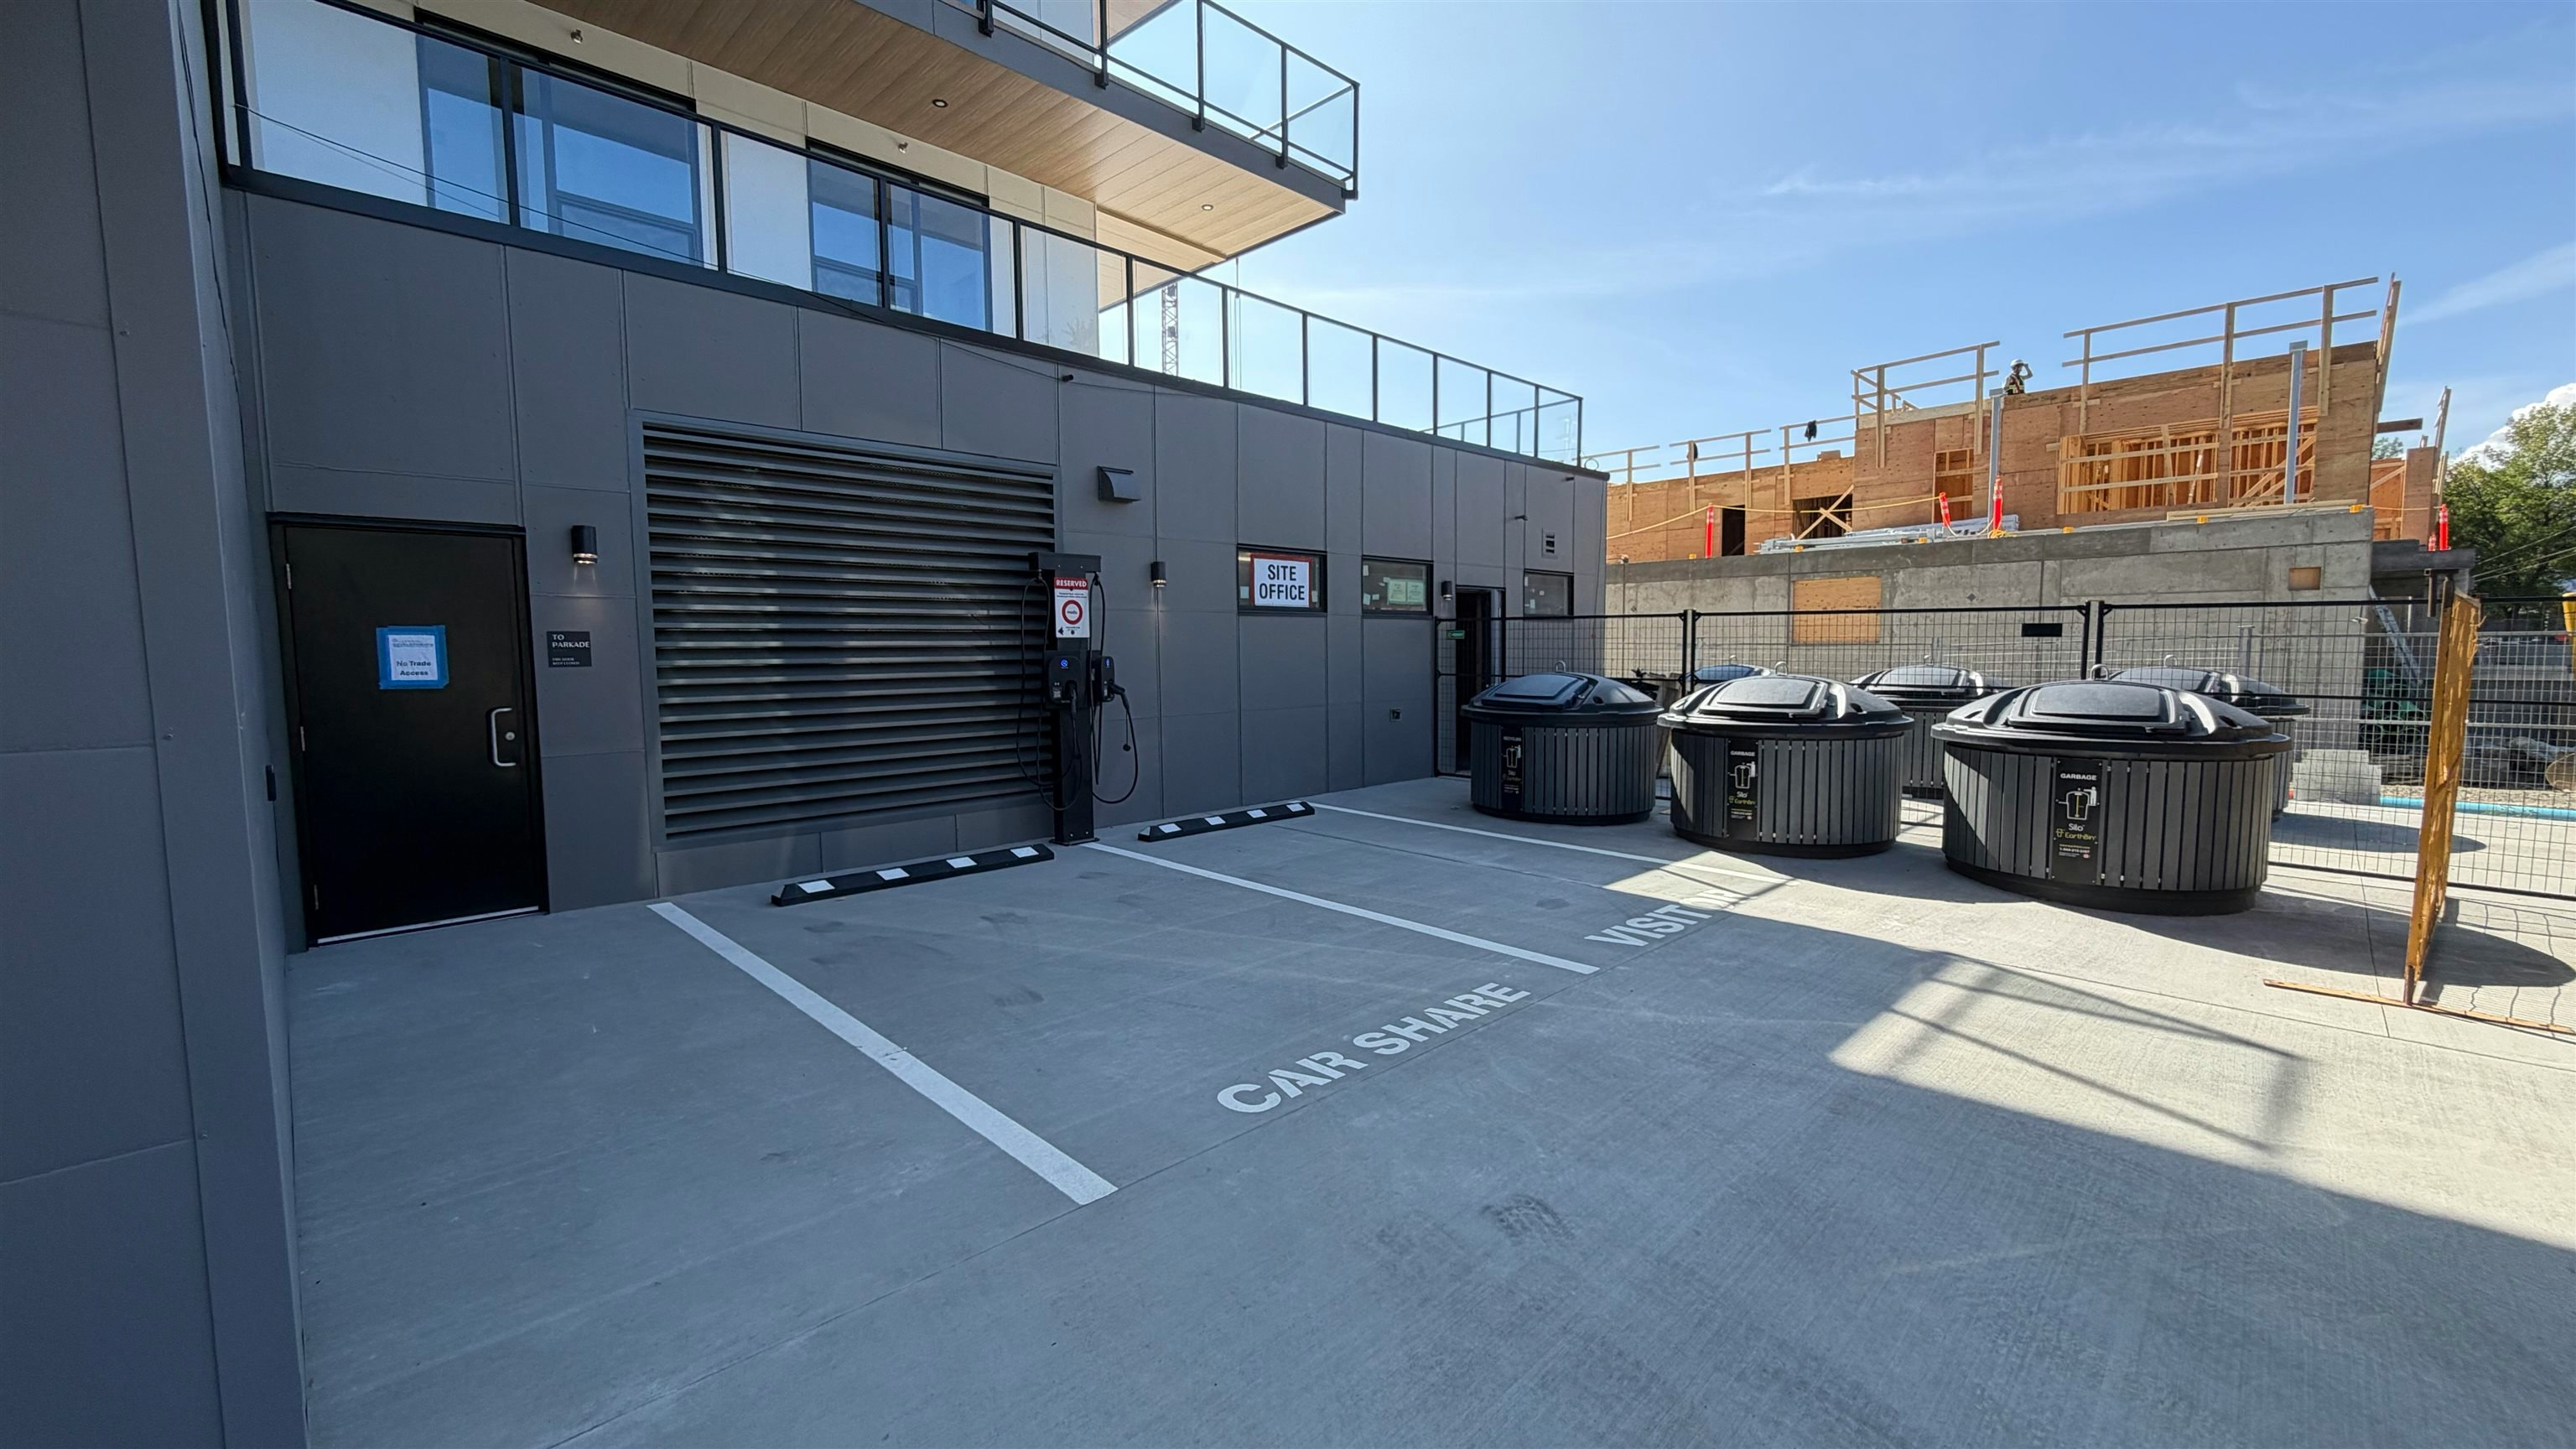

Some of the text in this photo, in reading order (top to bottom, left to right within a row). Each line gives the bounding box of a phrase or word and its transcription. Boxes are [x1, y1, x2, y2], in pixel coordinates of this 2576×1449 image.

[1268, 564, 1296, 581] SITE
[1056, 579, 1087, 588] RESERVED
[1259, 583, 1305, 600] OFFICE
[2068, 823, 2084, 832] Silo
[1216, 982, 1532, 1114] CAR SHARE
